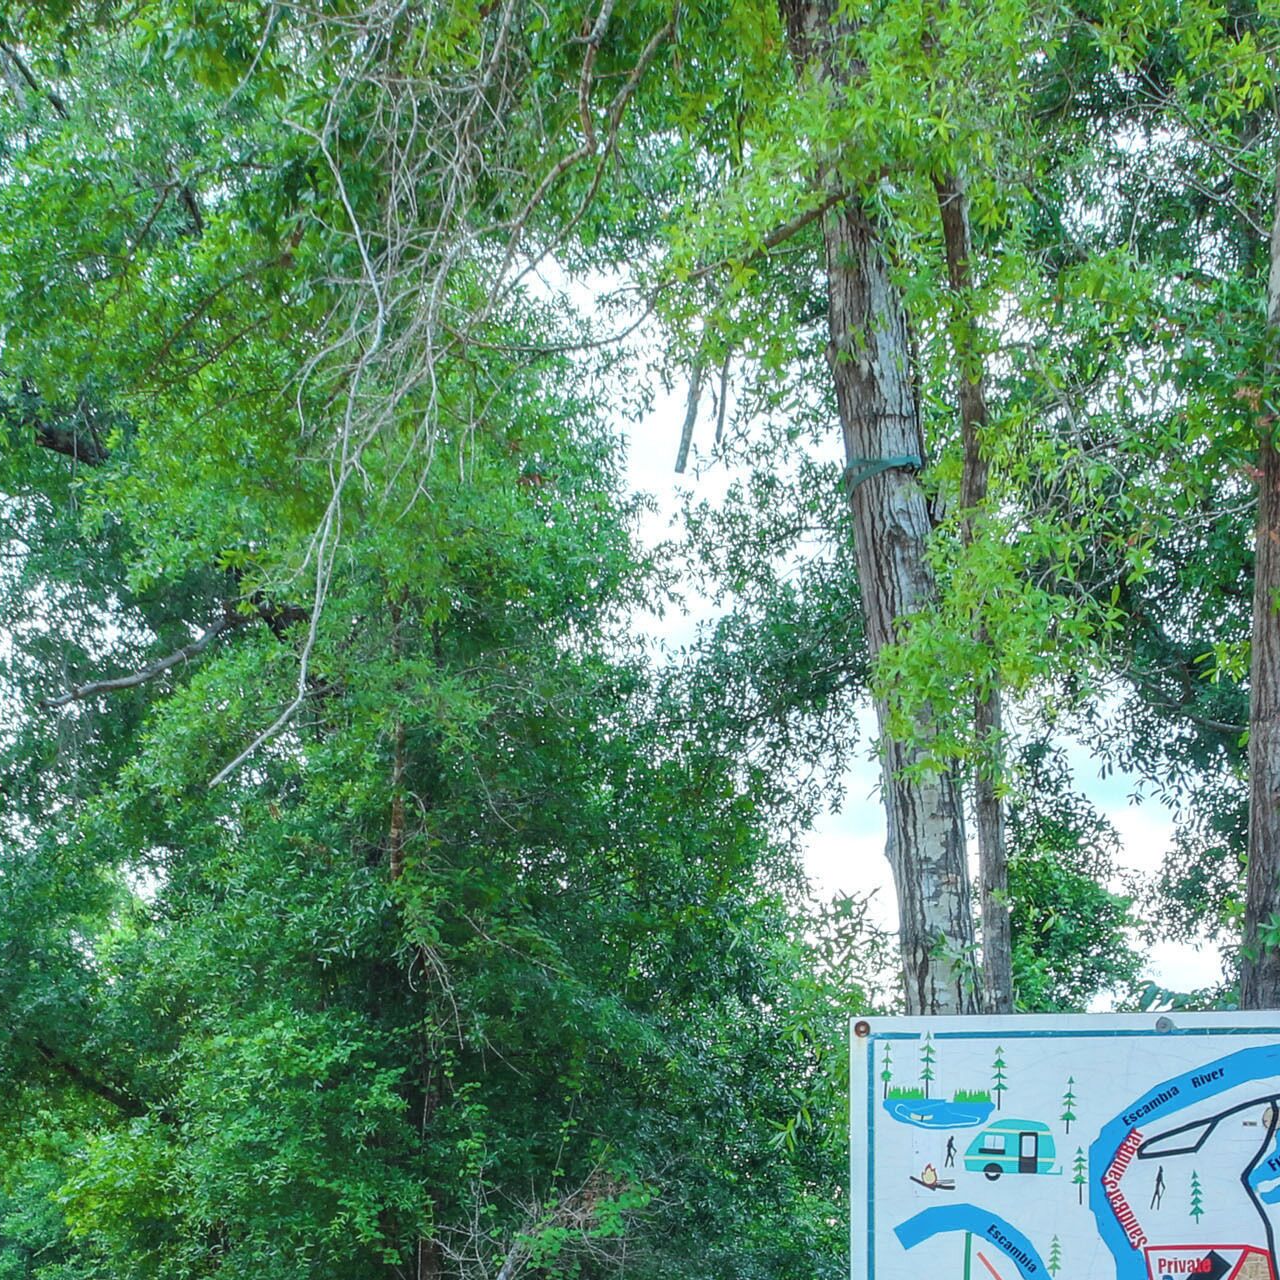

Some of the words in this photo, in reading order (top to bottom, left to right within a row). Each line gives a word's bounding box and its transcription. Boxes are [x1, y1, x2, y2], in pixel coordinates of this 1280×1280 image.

[1122, 1086, 1180, 1127] Escambia
[1191, 1067, 1225, 1089] River
[986, 1224, 1037, 1274] Escambia
[1158, 1257, 1213, 1274] Private
